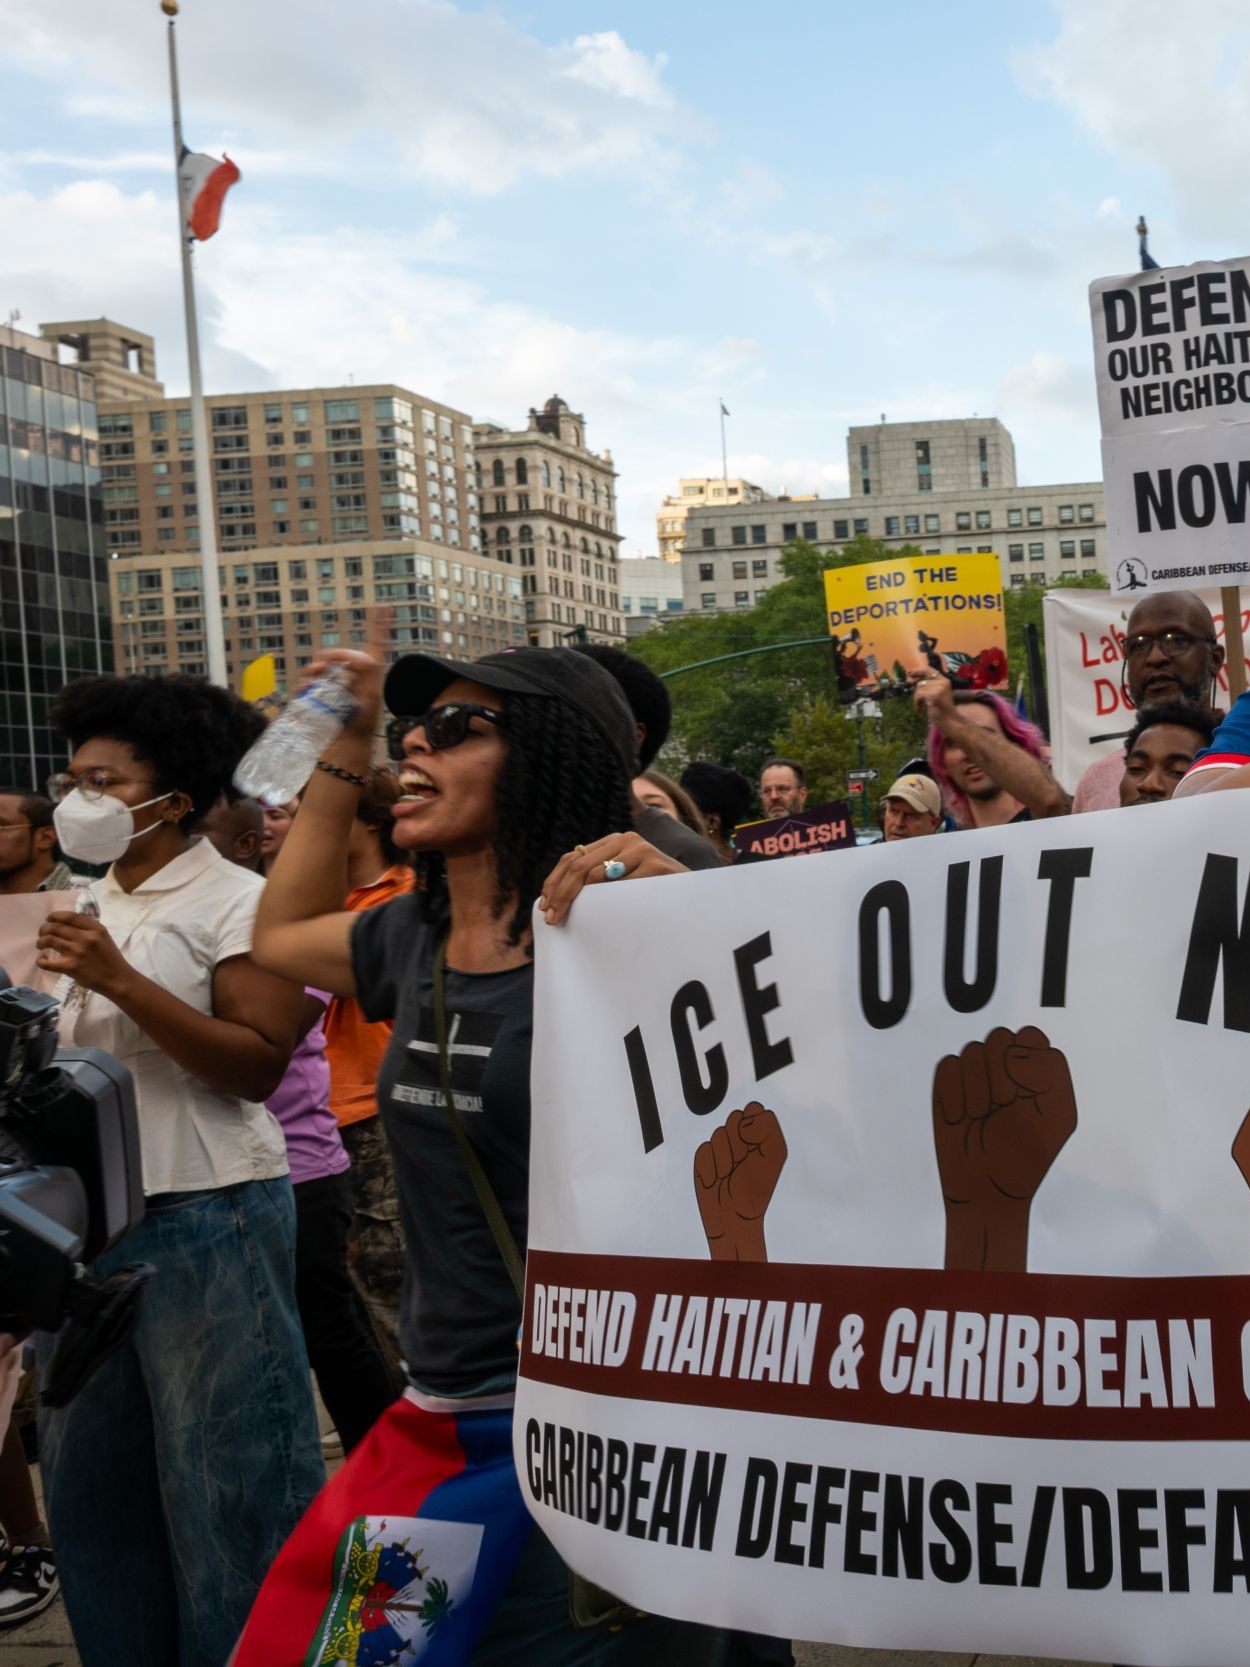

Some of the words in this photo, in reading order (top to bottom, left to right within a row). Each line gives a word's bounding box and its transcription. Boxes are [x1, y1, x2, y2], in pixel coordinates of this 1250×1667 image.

[1108, 341, 1174, 381] OUR
[866, 572, 905, 591] END
[913, 567, 957, 583] THE
[1151, 565, 1206, 581] CARIBBEAN
[830, 594, 1002, 627] DEPORTATIONS!
[750, 820, 847, 856] ABOLISH
[623, 930, 794, 1154] ICE
[858, 847, 1094, 1030] OUT
[531, 1283, 637, 1368] DEFEND
[640, 1293, 822, 1386] HAITIAN
[828, 1313, 865, 1391] &
[879, 1307, 1216, 1408] CARIBBEAN
[525, 1417, 727, 1552] CARIBBEAN
